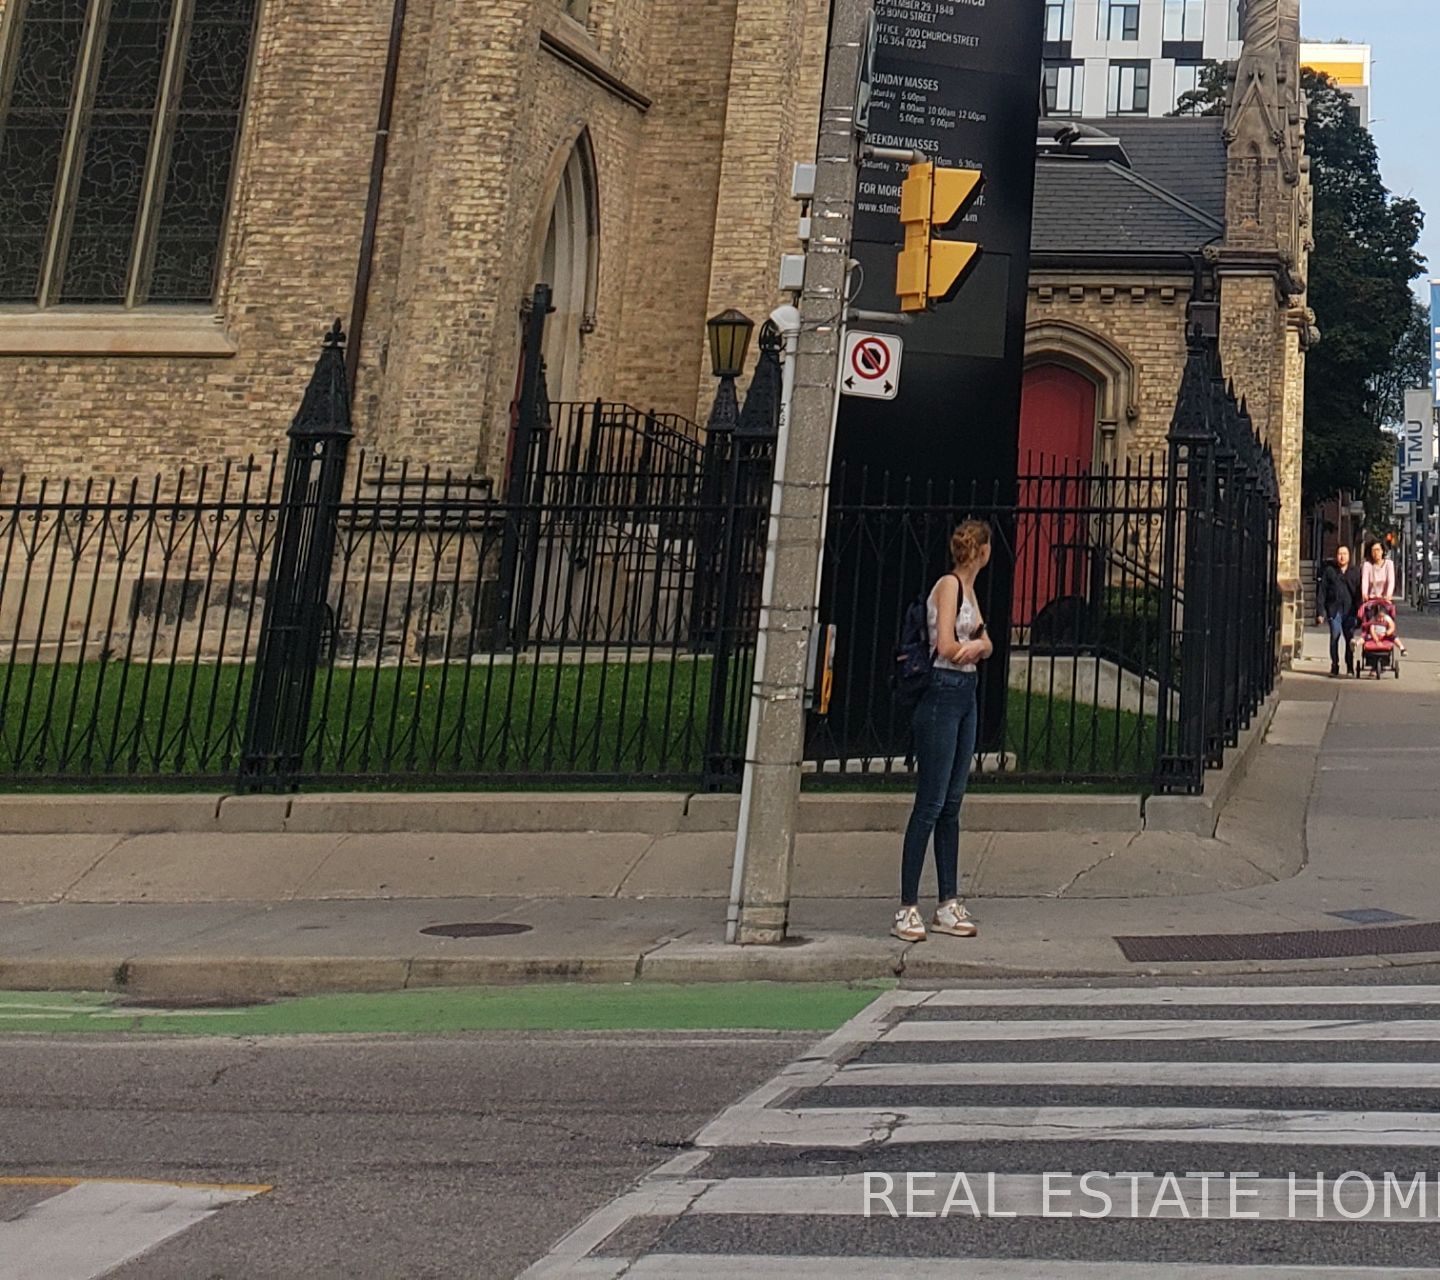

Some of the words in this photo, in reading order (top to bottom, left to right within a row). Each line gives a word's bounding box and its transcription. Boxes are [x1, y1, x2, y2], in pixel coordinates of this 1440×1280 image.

[887, 8, 908, 20] BOND
[909, 10, 937, 23] STREET
[935, 3, 954, 16] 1848
[876, 23, 900, 35] FFICE
[905, 27, 921, 39] 200
[921, 29, 952, 43] CHURCH
[952, 34, 980, 47] STREET
[872, 71, 904, 86] SUNDAY
[904, 76, 939, 91] MASSES
[865, 132, 905, 148] WEEKDAY
[905, 136, 939, 151] MASSES
[862, 158, 890, 172] Saturday
[859, 182, 876, 195] FOR
[877, 184, 902, 197] MORE
[1407, 419, 1424, 467] TMU
